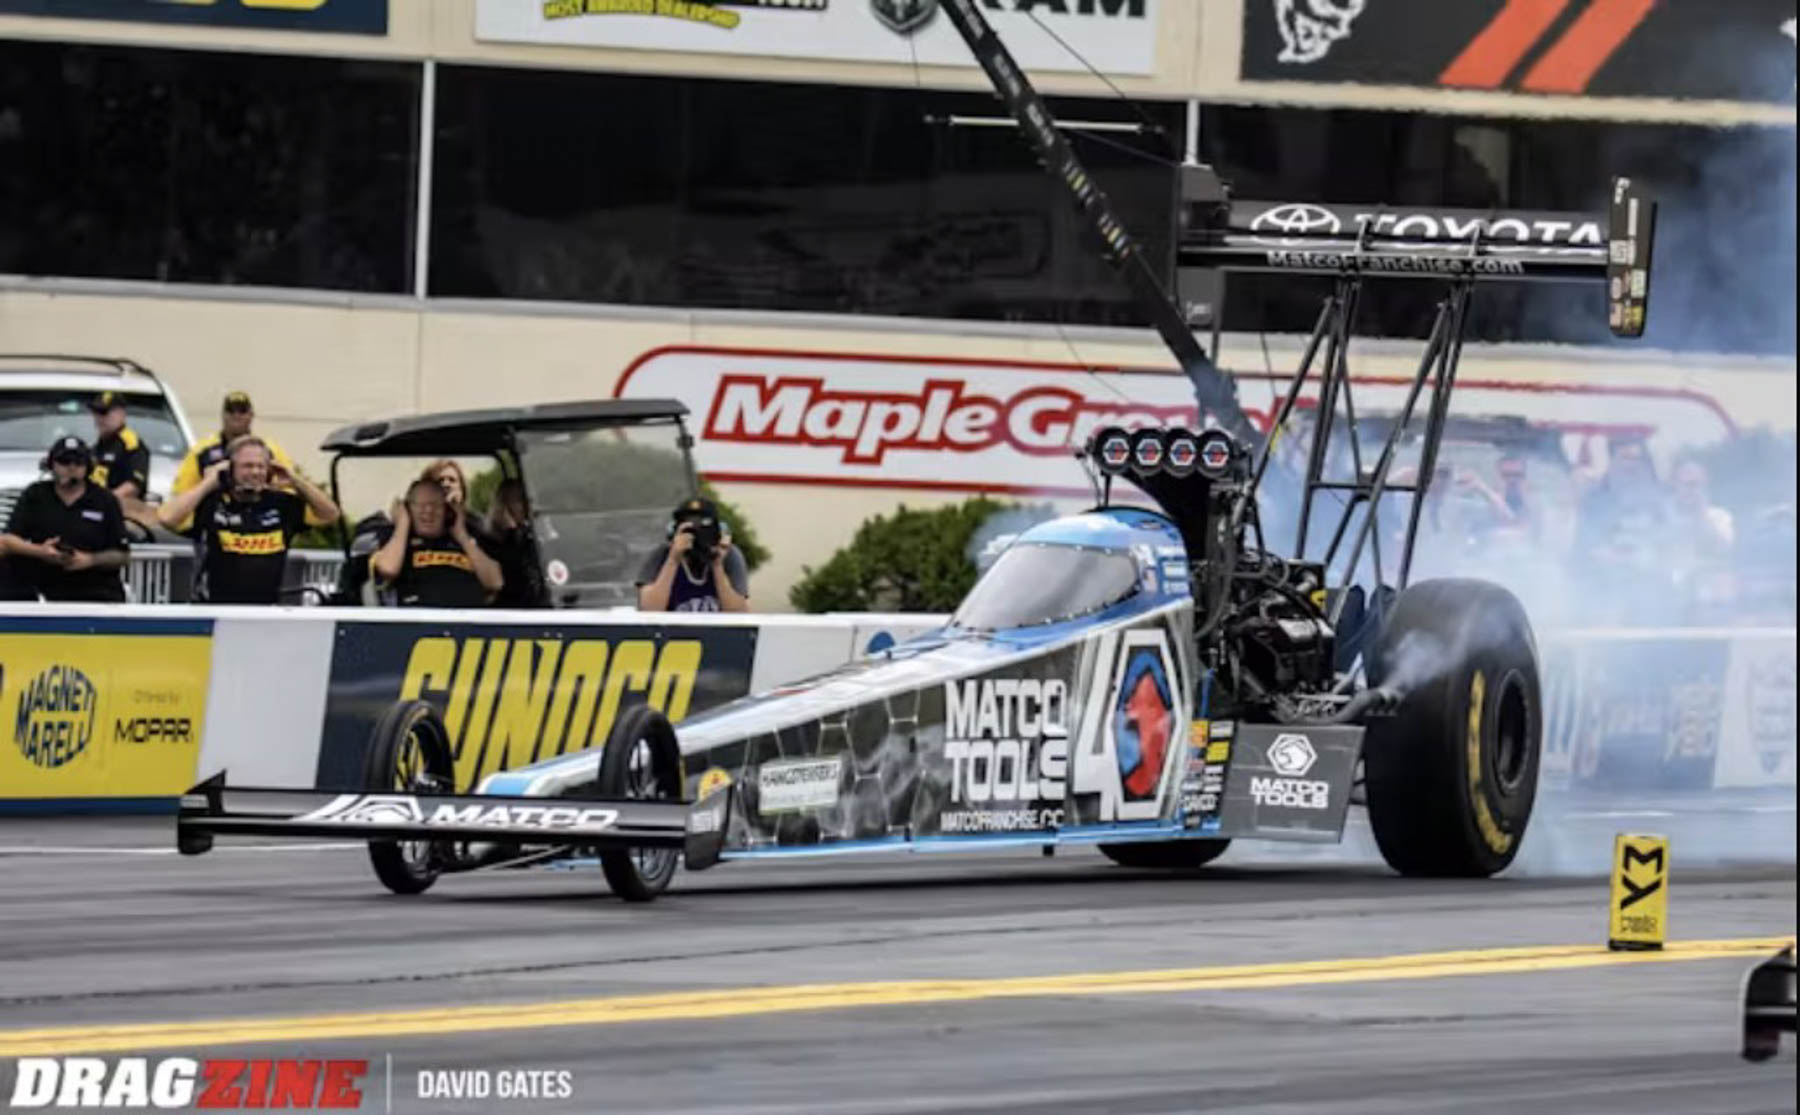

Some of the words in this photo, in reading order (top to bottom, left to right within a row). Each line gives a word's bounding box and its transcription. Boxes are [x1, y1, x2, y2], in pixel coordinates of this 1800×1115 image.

[1355, 213, 1603, 254] TOYOTA
[706, 377, 996, 463] Maple
[944, 679, 1068, 738] MATCO
[114, 717, 192, 743] MOPAR
[944, 739, 1067, 802] TOOLS
[1250, 777, 1329, 795] MATCO
[427, 804, 620, 830] MATCO
[1254, 792, 1329, 809] TOOLS
